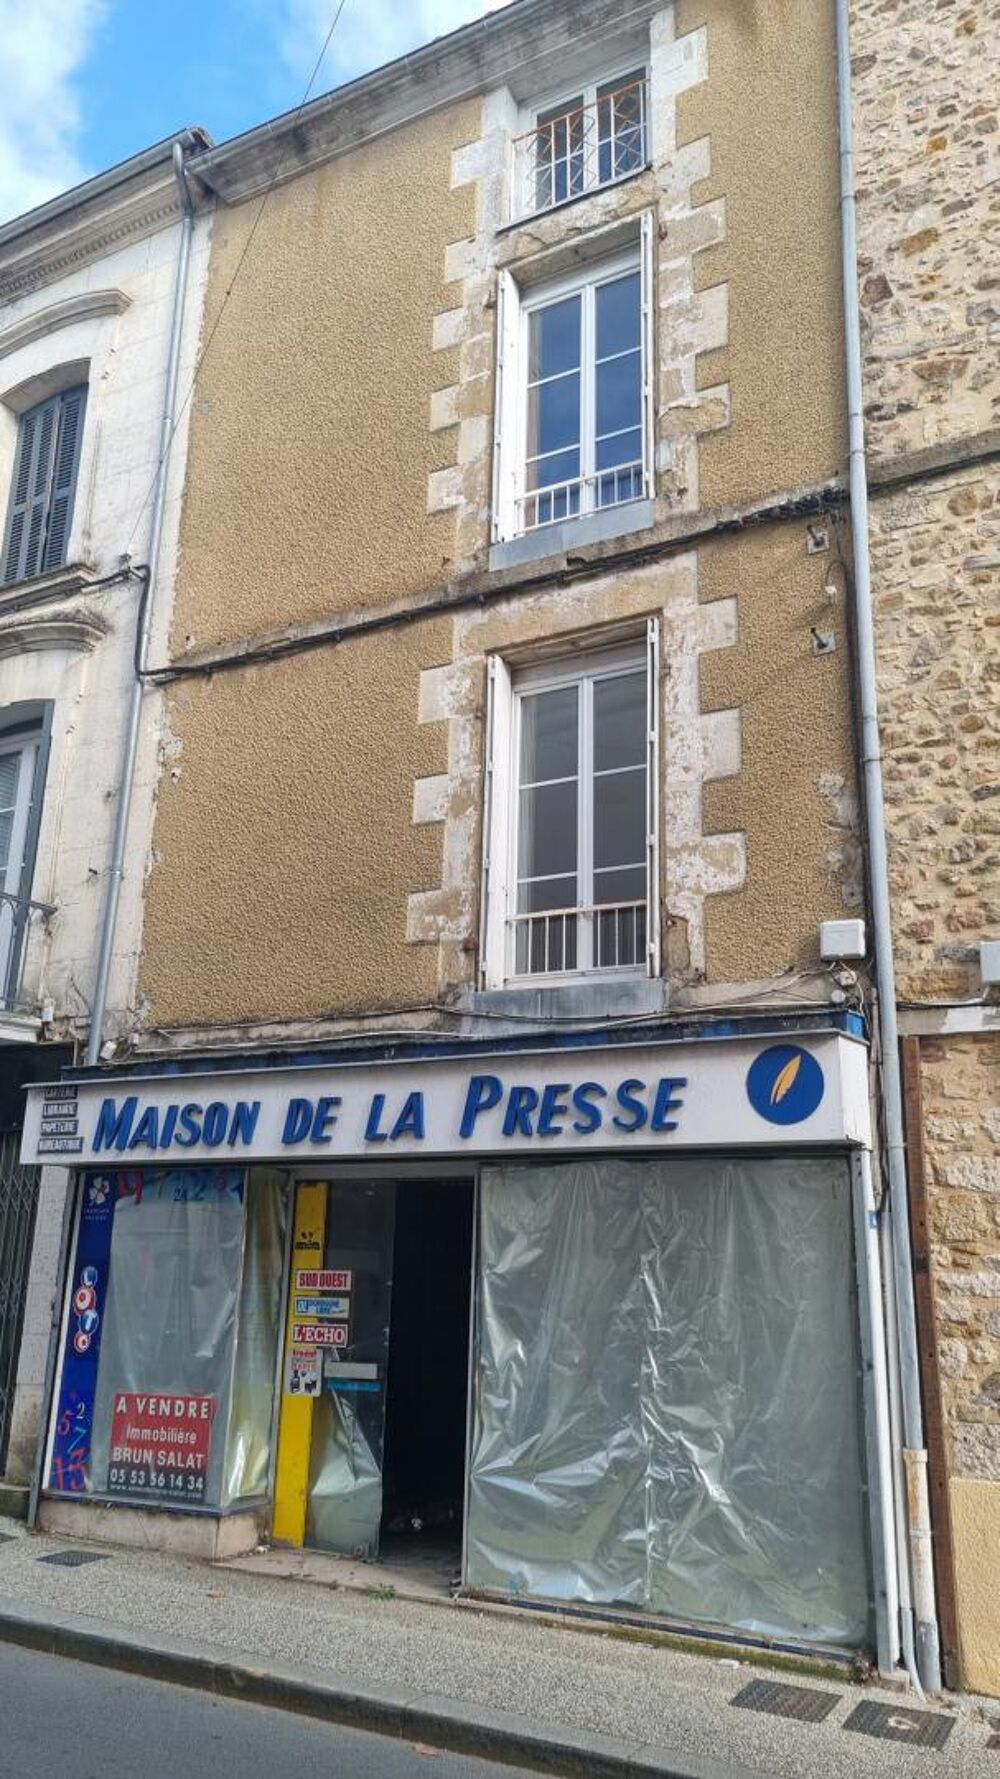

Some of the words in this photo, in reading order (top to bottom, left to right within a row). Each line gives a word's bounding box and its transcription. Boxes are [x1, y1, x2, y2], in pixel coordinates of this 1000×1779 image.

[92, 1096, 261, 1151] MAISON
[281, 1096, 342, 1145] DE
[364, 1091, 425, 1142] LA
[459, 1075, 688, 1139] PRESSE
[294, 1326, 345, 1344] L'ECHO
[116, 1397, 127, 1413] A
[136, 1398, 209, 1419] VENDRE
[112, 1447, 153, 1464] BRUN
[157, 1450, 205, 1469] SALAT
[110, 1469, 126, 1483] 05
[130, 1470, 146, 1485] 53
[150, 1472, 165, 1487] 56
[170, 1474, 183, 1488] 14
[187, 1476, 204, 1490] 34
